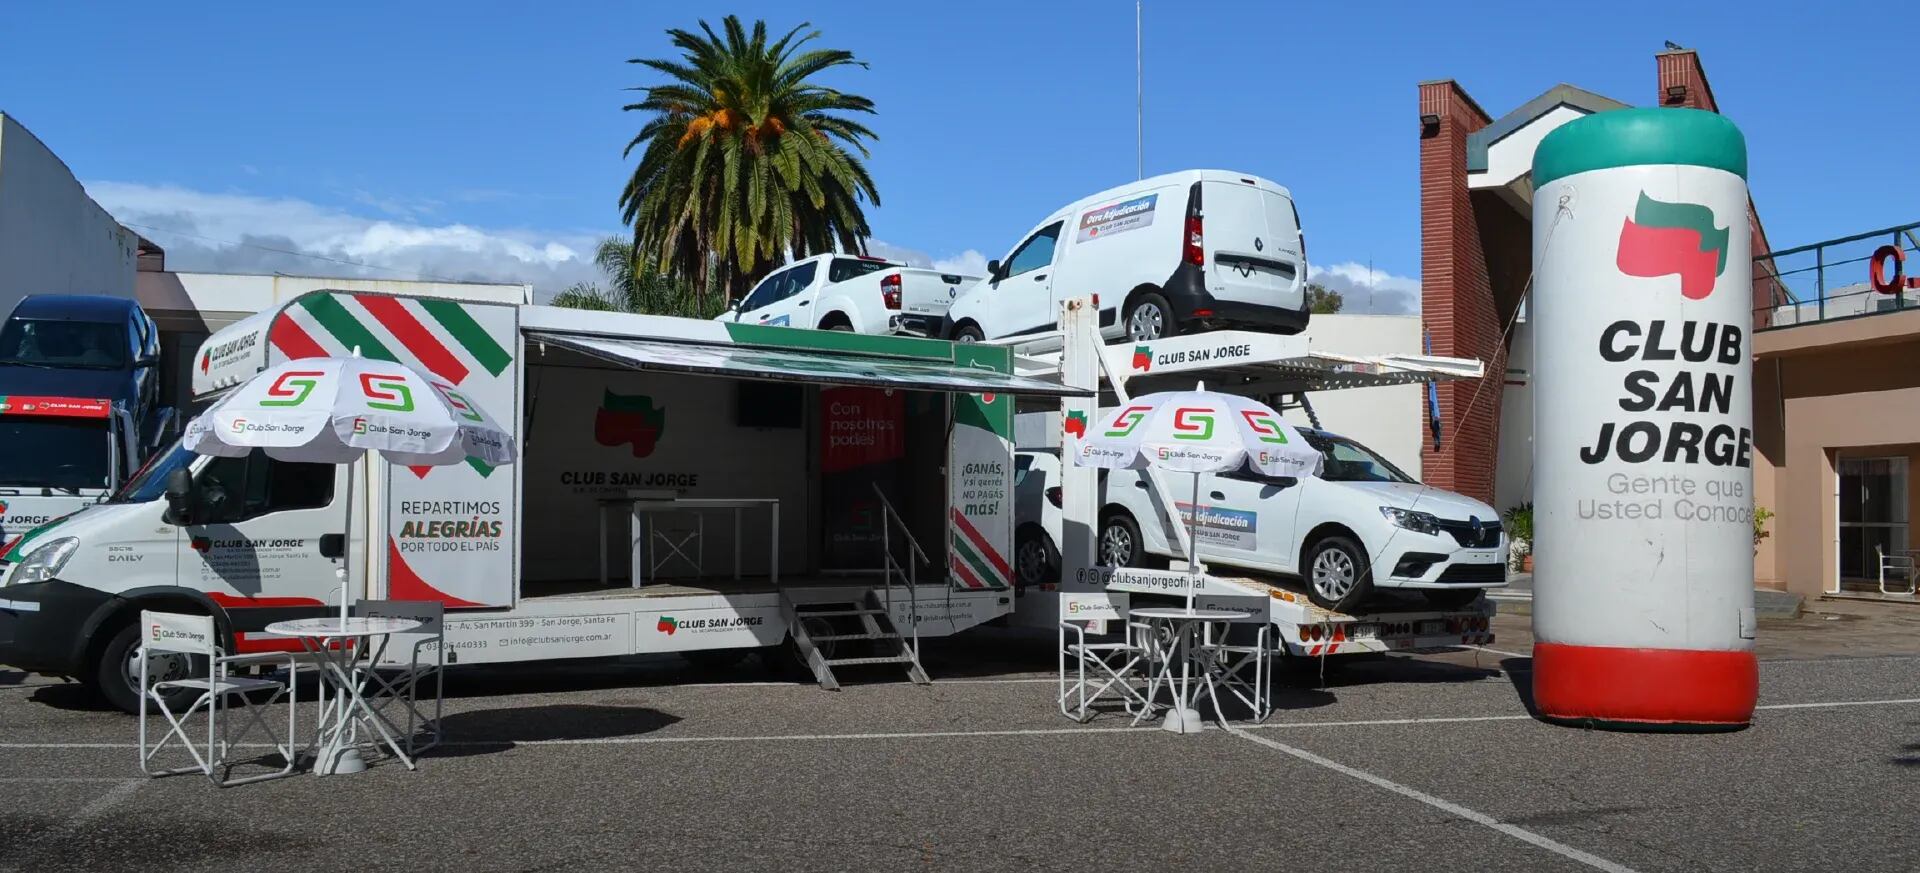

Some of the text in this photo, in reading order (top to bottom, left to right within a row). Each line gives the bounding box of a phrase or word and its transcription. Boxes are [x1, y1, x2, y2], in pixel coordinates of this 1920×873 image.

[1086, 200, 1150, 224] Otra Adjudicación
[1599, 319, 1742, 366] CLUB
[1158, 344, 1251, 366] CLUB SAN JORGE
[1618, 370, 1734, 415] SAN
[830, 402, 861, 416] Con
[246, 423, 304, 434] Club San Jorge
[830, 417, 894, 431] nosotros
[368, 424, 431, 440] Club San Jorge
[830, 433, 875, 448] podés
[1579, 420, 1751, 469] JORGE
[1170, 451, 1186, 459] Club
[1202, 453, 1223, 462] Jorge
[962, 460, 1004, 476] ¡GANÁS,
[560, 471, 698, 486] CLUB SAN JORGE
[1607, 472, 1744, 498] Gente que
[962, 488, 1004, 500] NO PAGÁS
[401, 501, 500, 515] REPARTIMOS
[964, 500, 999, 516] más!
[1578, 498, 1752, 525] Usted Conoce
[400, 516, 503, 538] ALEGRÍAS
[214, 539, 304, 548] CLUB SAN JORGE
[401, 538, 500, 552] POR TODO EL PAÍS
[519, 619, 534, 628] 399
[542, 619, 555, 627] San
[558, 618, 582, 627] Jorge,
[679, 617, 763, 629] CLUB SAN JORGE
[162, 630, 205, 642] Club San Jorge
[426, 640, 488, 650] 0306 440333
